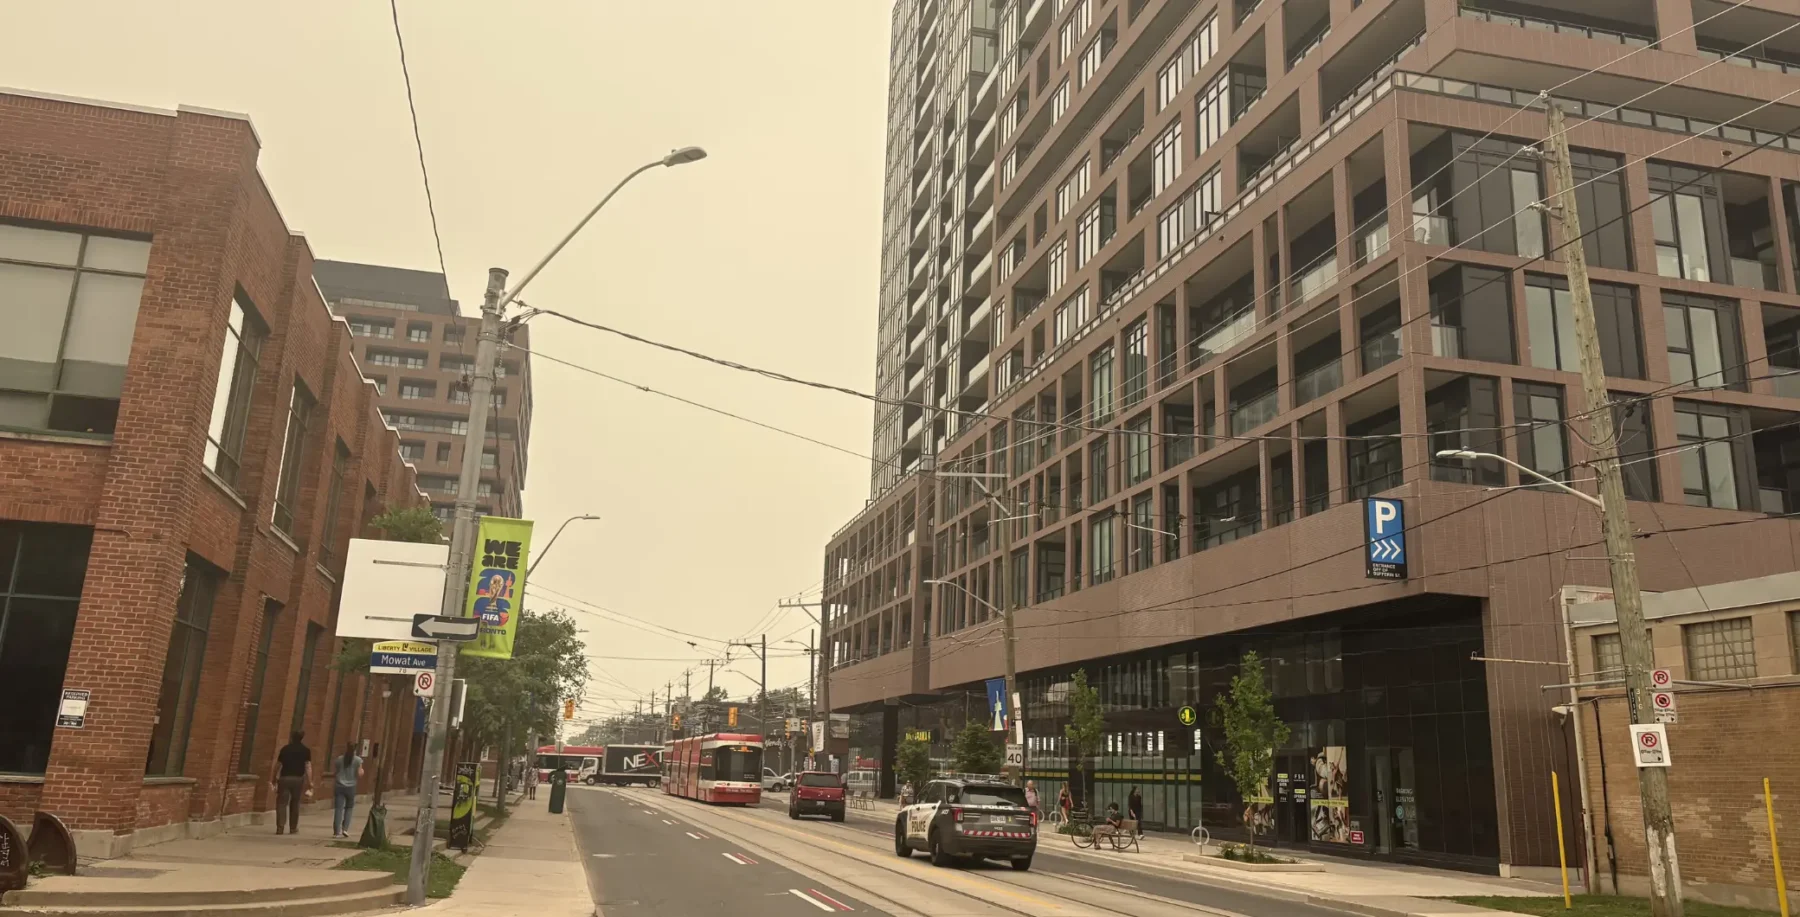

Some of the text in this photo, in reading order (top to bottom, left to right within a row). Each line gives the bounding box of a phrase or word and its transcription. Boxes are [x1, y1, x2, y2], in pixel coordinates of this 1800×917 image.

[1375, 500, 1396, 534] P
[484, 539, 522, 557] WE
[482, 613, 499, 622] FIFA
[480, 627, 507, 635] RONTO
[381, 654, 426, 667] Mowat Ave
[623, 749, 664, 770] NEXT
[1007, 753, 1022, 764] 40
[982, 804, 1014, 812] POLICE
[912, 820, 926, 833] POLICE
